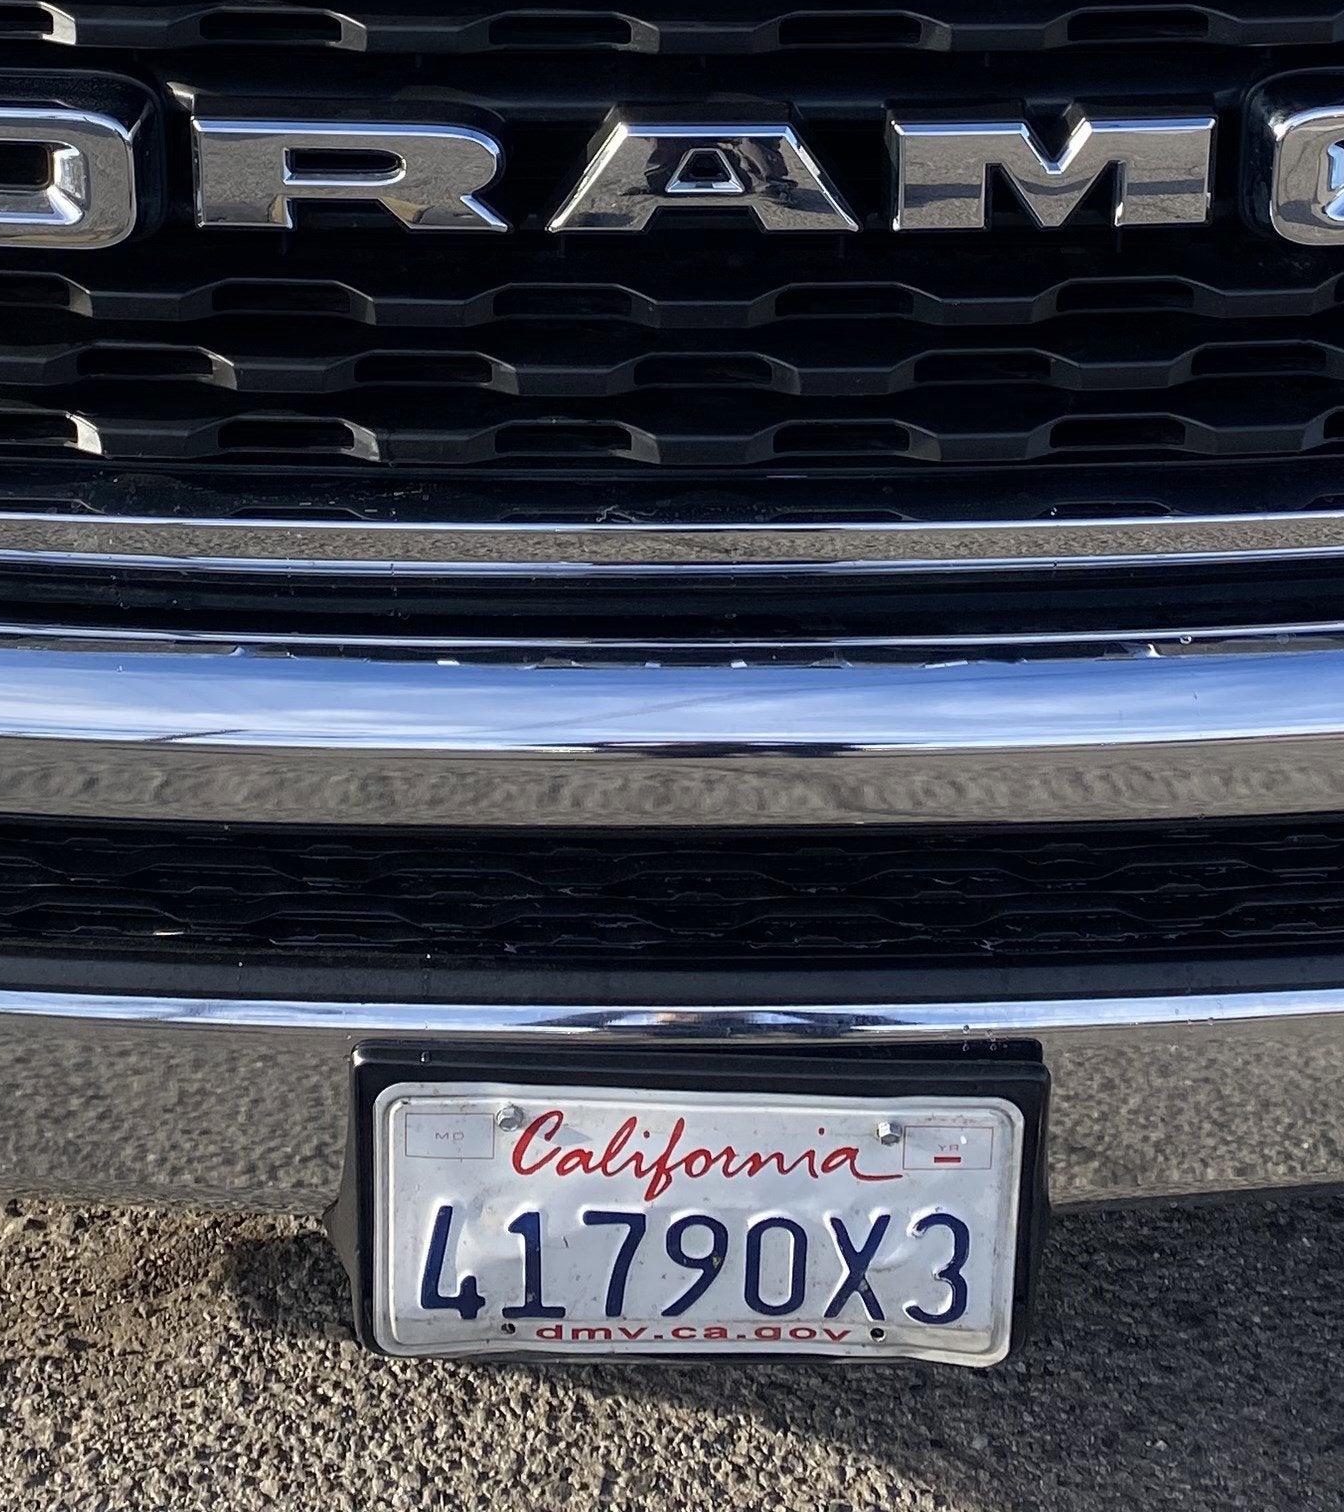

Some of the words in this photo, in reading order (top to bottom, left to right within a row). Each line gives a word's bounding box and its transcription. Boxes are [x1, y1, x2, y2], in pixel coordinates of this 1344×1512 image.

[188, 110, 1221, 233] RAM
[511, 1110, 904, 1201] California
[419, 1204, 971, 1324] 41790X3
[534, 1324, 852, 1342] dmv.ca.gov
